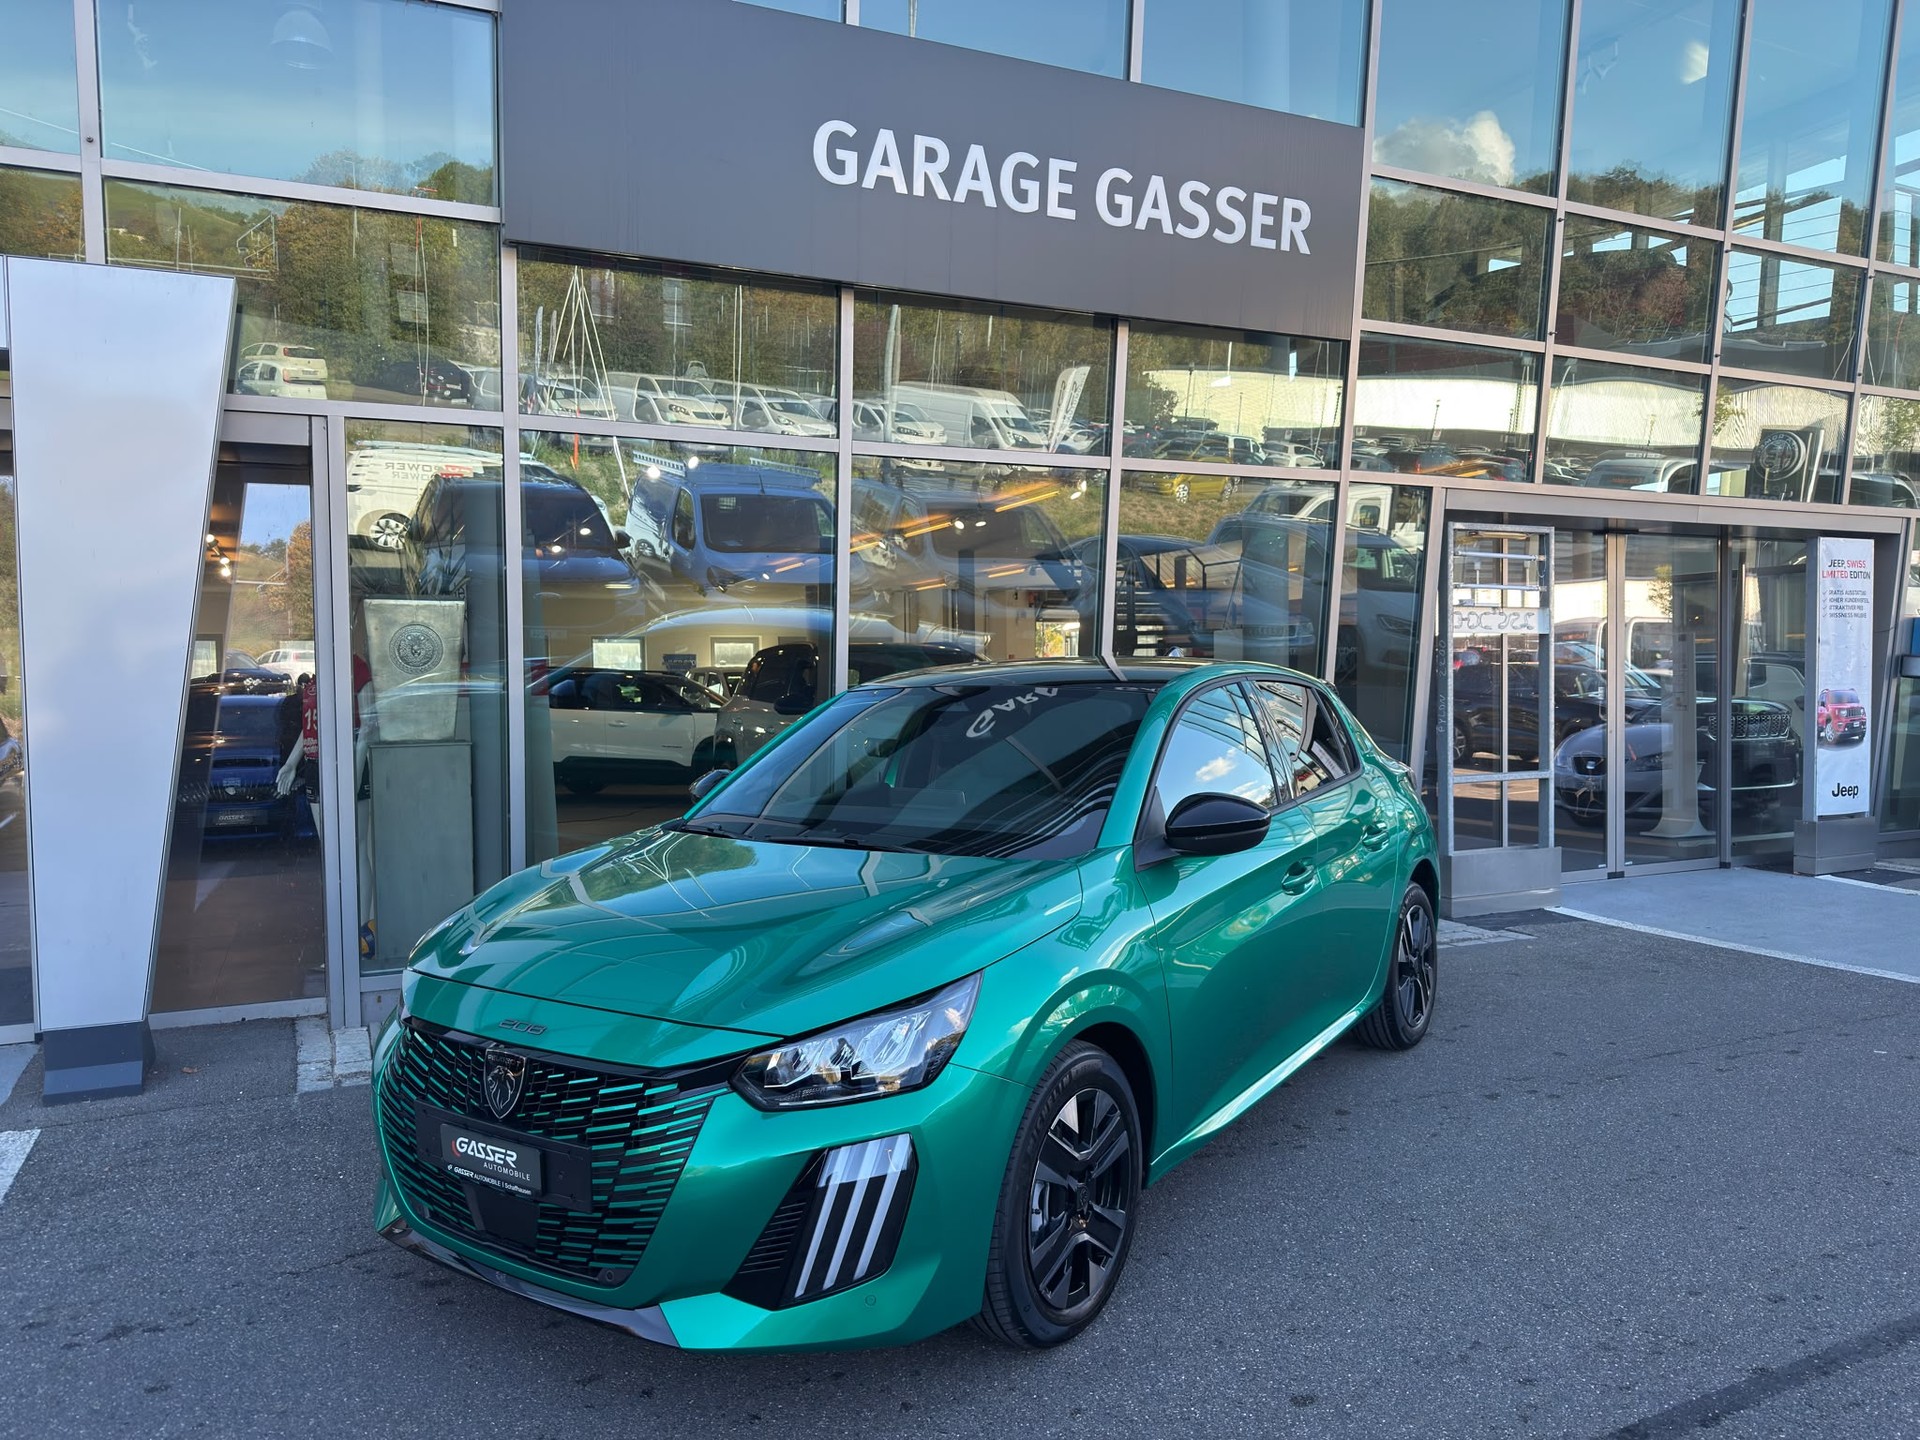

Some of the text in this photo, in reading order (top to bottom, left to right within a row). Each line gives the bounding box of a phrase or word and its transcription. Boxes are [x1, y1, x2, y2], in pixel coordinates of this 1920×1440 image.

[813, 119, 1312, 255] GARAGE GASSER
[1846, 560, 1866, 568] SWISS
[1831, 783, 1859, 799] Jeep
[499, 1019, 547, 1035] 208
[455, 1137, 517, 1168] GASSER
[453, 1166, 474, 1178] GASSER
[473, 1172, 501, 1187] AUTOMOBILE
[483, 1161, 531, 1181] AUTOMOBILE
